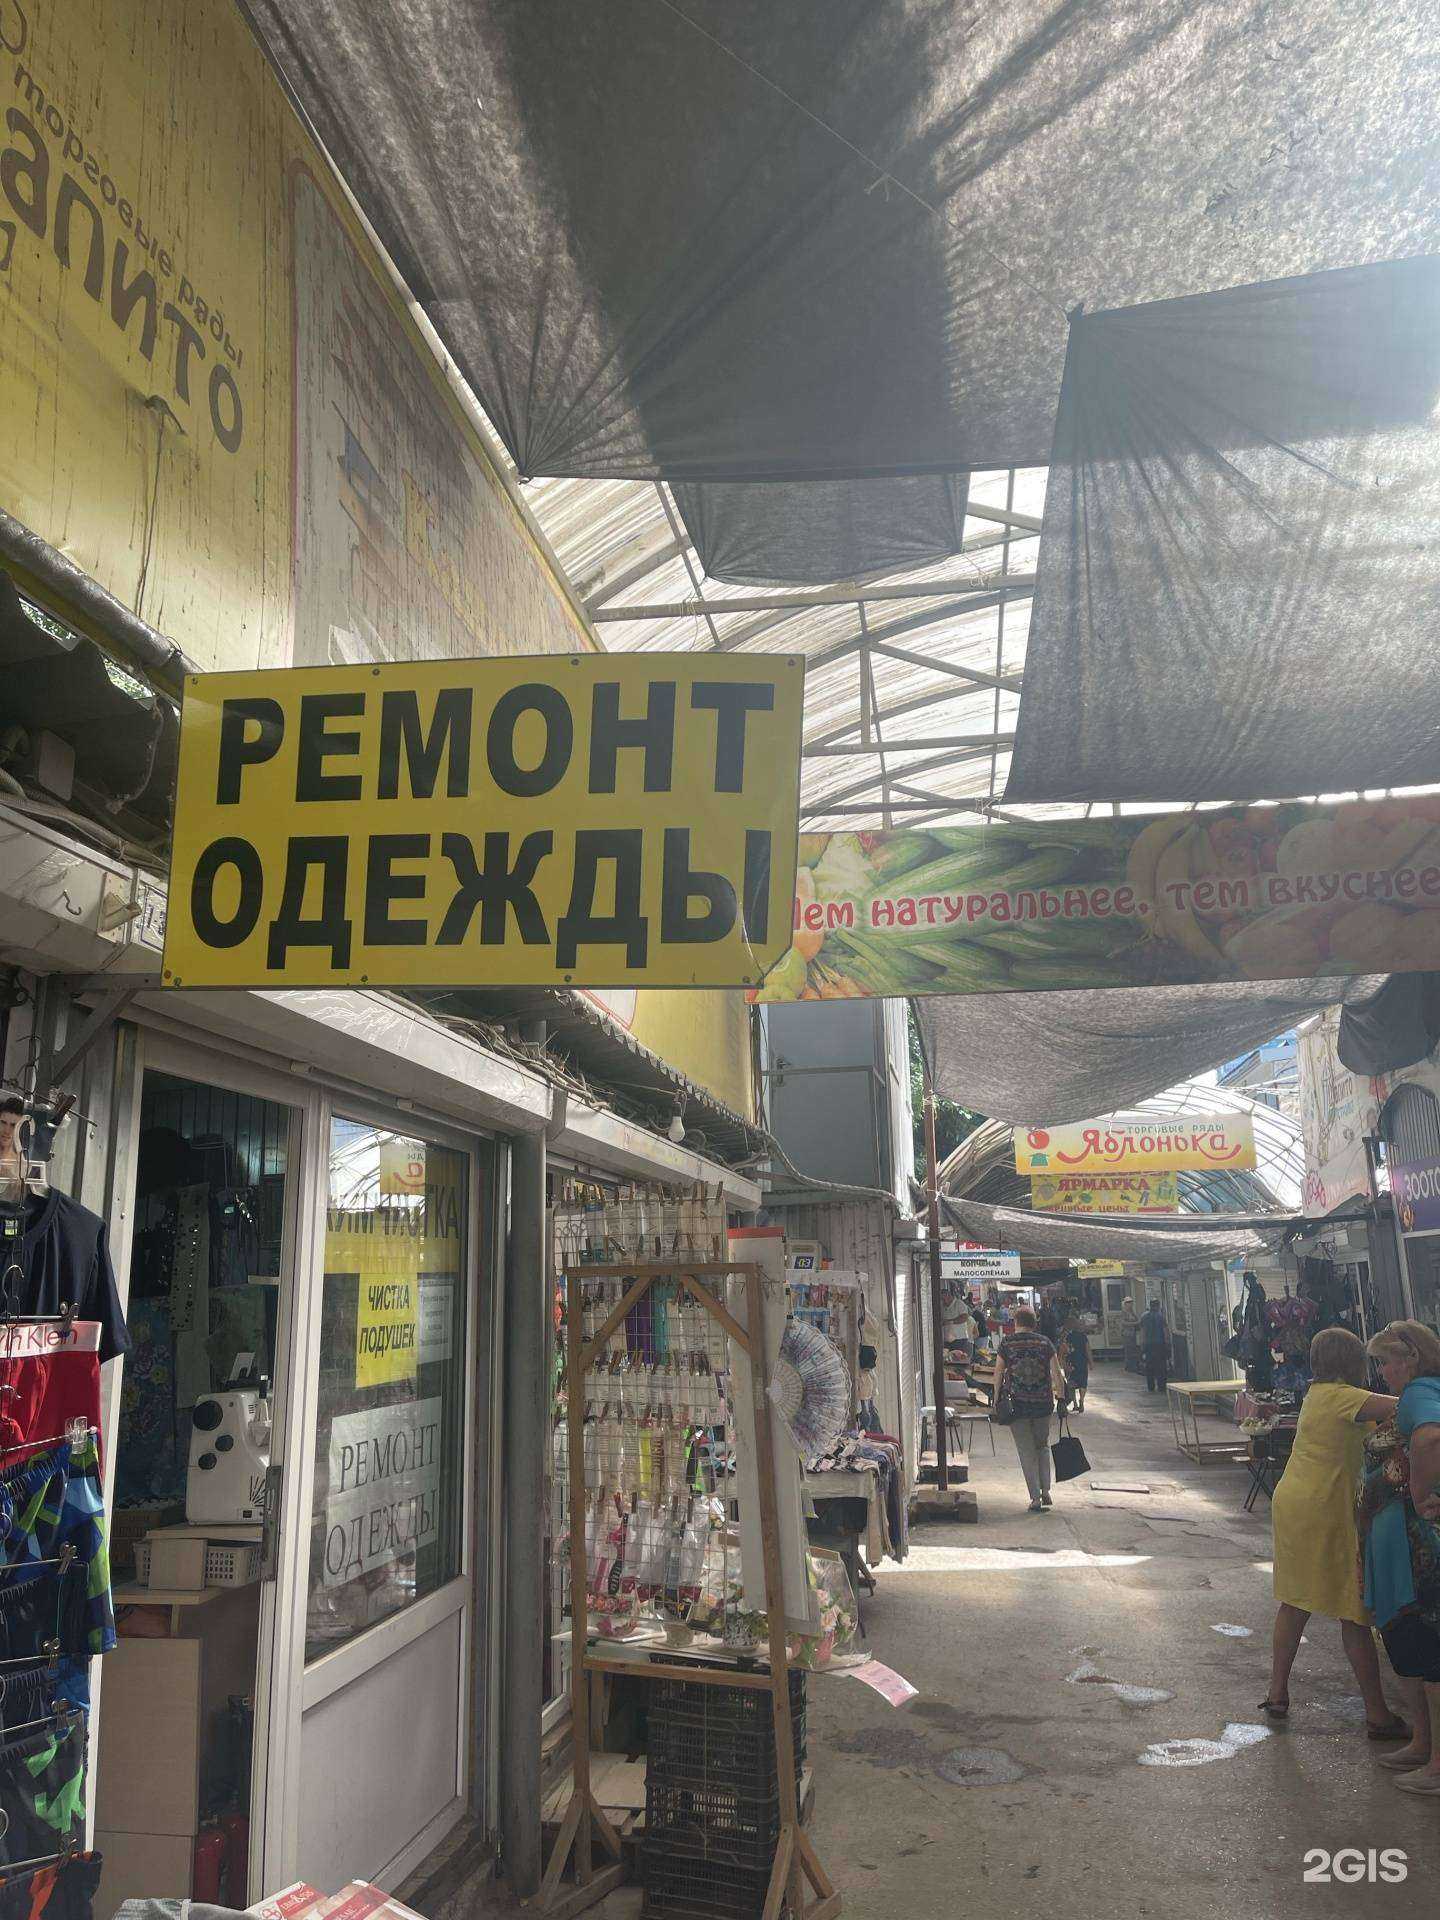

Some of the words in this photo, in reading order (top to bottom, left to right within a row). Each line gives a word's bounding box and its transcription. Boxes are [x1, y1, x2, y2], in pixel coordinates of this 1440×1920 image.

[14, 62, 173, 278] торговые
[177, 274, 243, 370] ряды
[215, 681, 775, 805] РЕМОНТ
[190, 828, 773, 970] ОДЕЖДЫ
[1166, 880, 1250, 911] тем
[1056, 1129, 1242, 1164] Яблонька
[1057, 1178, 1150, 1191] ЯРМАРКА
[368, 1284, 411, 1311] ЧИСТКА
[358, 1323, 416, 1359] ПОДУШЕК
[338, 1423, 438, 1495] РЕМОНТ
[326, 1488, 438, 1581] ОДЕЖДЫ
